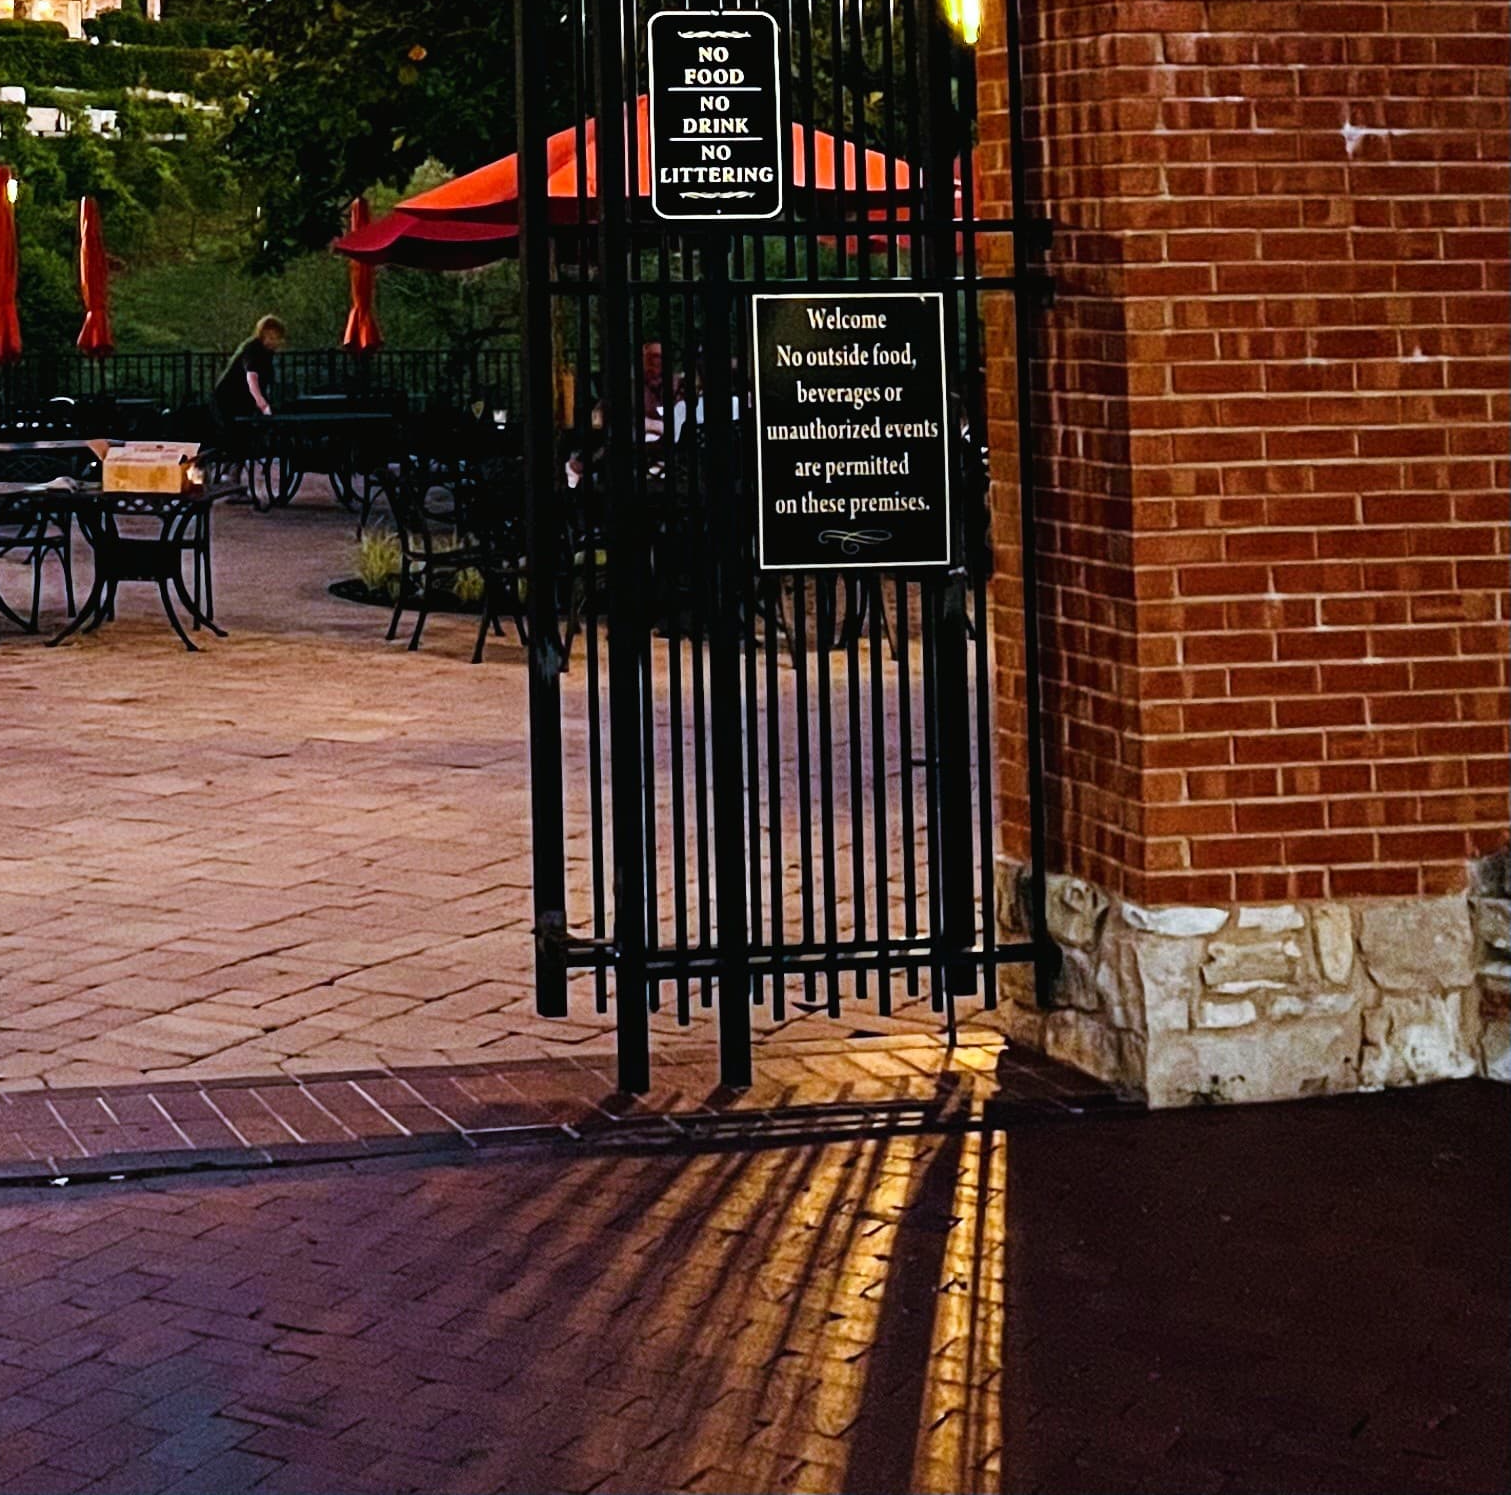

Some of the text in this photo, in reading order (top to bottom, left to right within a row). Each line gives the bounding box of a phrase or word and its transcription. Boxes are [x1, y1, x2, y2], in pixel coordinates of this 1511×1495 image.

[698, 46, 729, 62] NO
[684, 69, 744, 85] FOOD
[700, 96, 730, 112] NO
[682, 118, 749, 134] DRINK
[701, 145, 732, 161] NO
[660, 167, 774, 183] LITTERING
[806, 306, 887, 329] Welcome
[776, 342, 917, 369] No outside food,
[796, 380, 903, 410] beverages or
[767, 416, 939, 440] unauthorized events
[794, 452, 910, 483] are permitted
[775, 490, 931, 519] on these premises.
